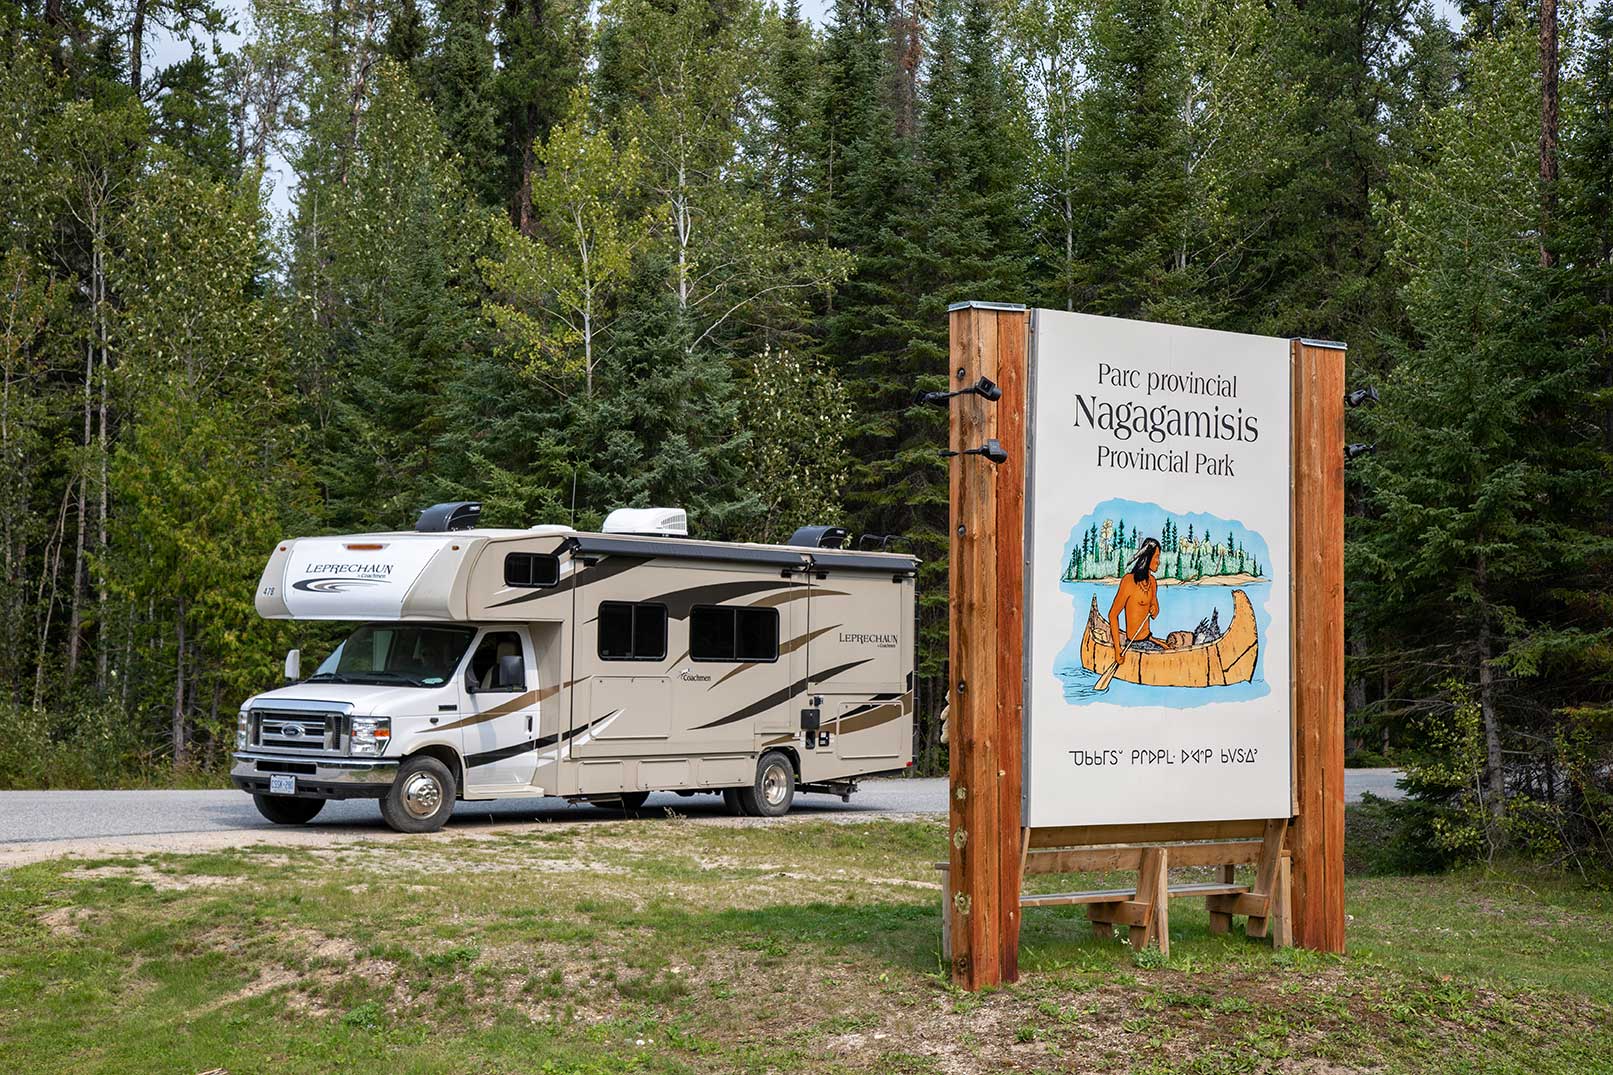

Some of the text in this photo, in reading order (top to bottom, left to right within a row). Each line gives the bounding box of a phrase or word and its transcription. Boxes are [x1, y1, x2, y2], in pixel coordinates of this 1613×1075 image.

[1098, 363, 1237, 398] Parc provincial
[1073, 394, 1259, 444] Nagagamisis
[1097, 445, 1235, 476] Provincial Park
[305, 563, 394, 575] LEPRECHAUN
[839, 632, 898, 645] LEPRECHAUN
